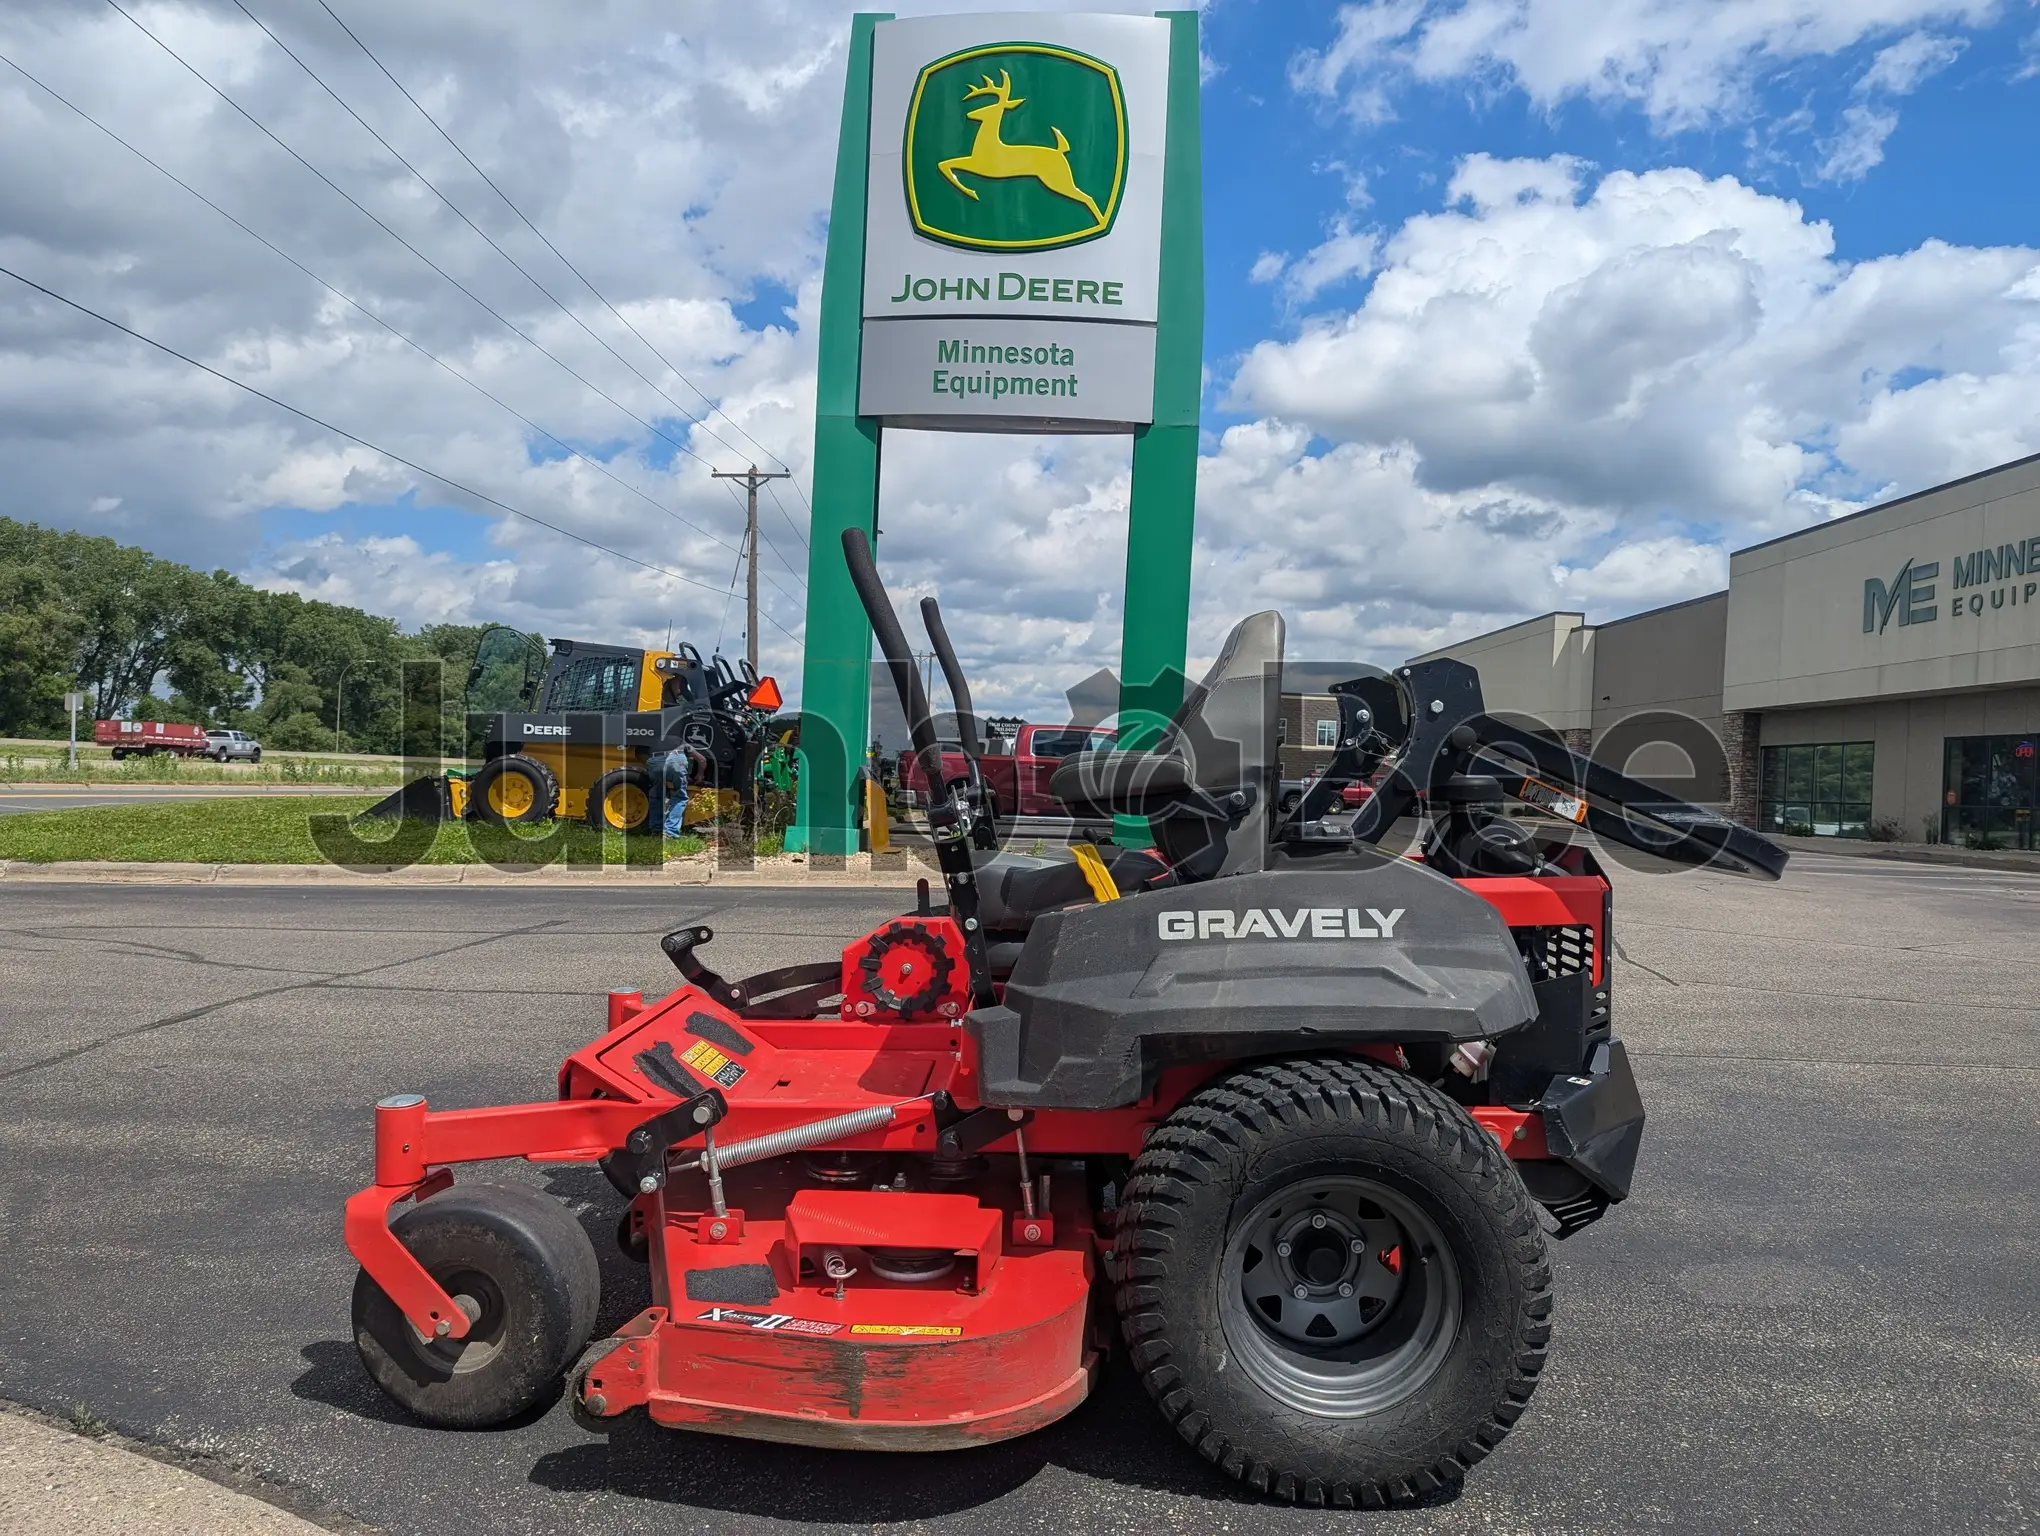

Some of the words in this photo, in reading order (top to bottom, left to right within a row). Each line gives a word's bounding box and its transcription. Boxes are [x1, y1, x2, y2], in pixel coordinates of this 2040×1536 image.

[891, 273, 990, 303] JOHN
[998, 272, 1124, 305] DEERE
[938, 339, 1074, 366] Minnesota
[933, 370, 1078, 400] Equipment
[1953, 536, 2040, 590] MINNE
[1863, 557, 1940, 635] ME
[1952, 582, 2037, 617] EQUIP
[523, 723, 572, 736] DEERE
[1157, 908, 1406, 941] GRAVELY
